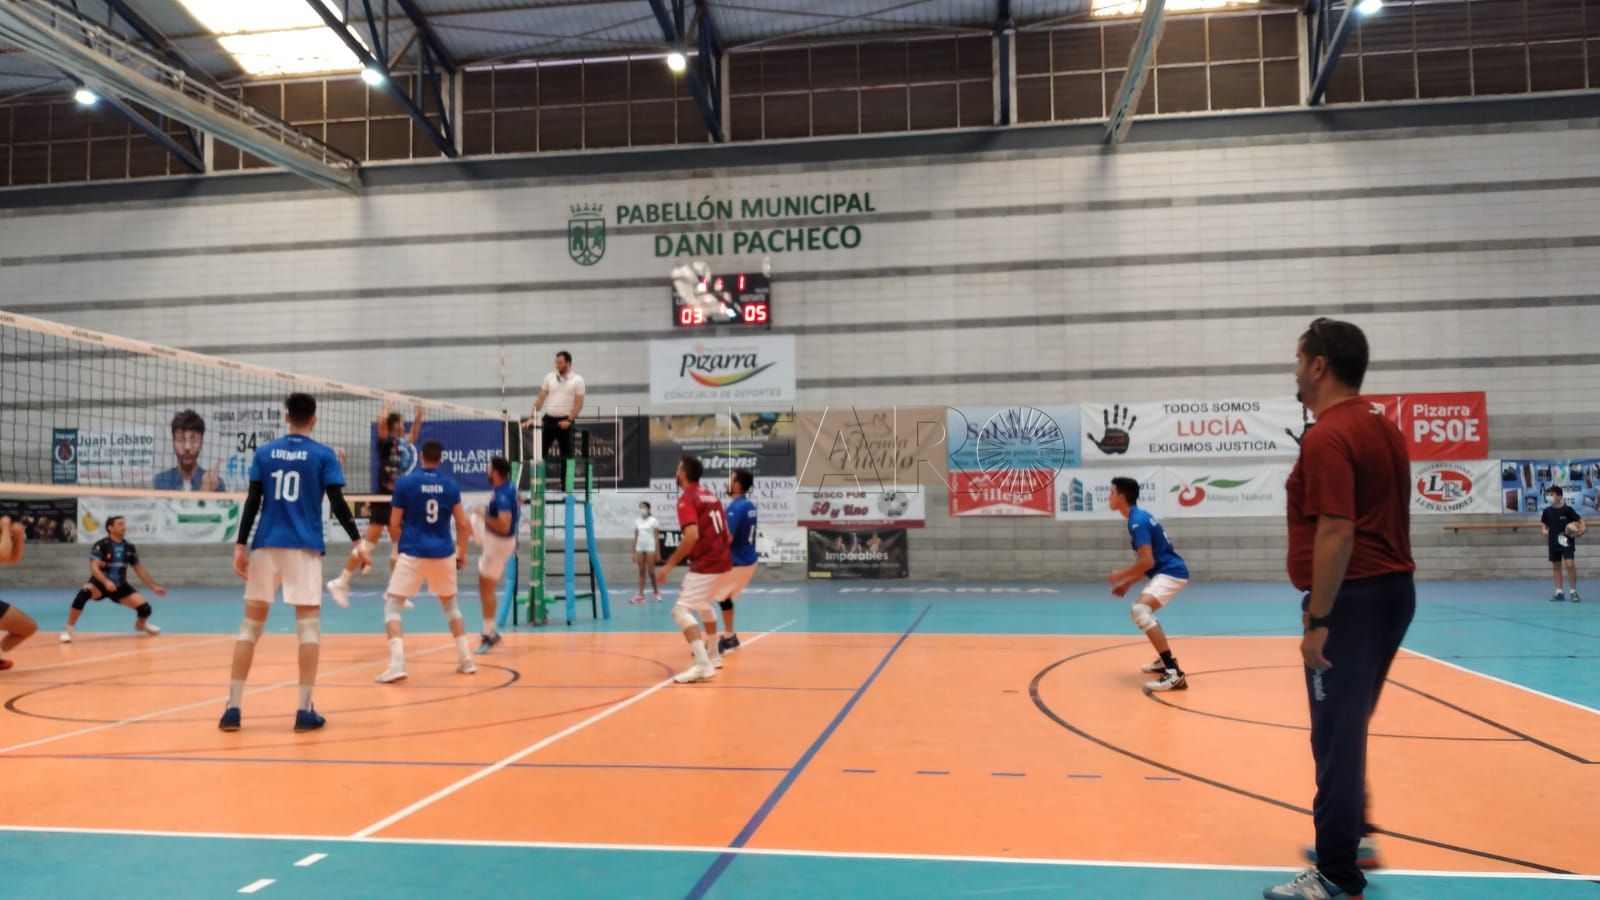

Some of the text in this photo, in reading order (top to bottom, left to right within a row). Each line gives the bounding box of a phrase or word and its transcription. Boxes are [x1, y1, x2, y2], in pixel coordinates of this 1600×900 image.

[616, 192, 876, 224] PABELLÓN MUNICIPAL
[654, 225, 862, 257] DANI PACHECO
[681, 308, 703, 324] 03
[744, 304, 767, 322] 05
[1163, 401, 1260, 414] TODOS SOMOS
[1413, 403, 1470, 417] Pizarra
[1177, 415, 1248, 437] LUCÍA
[1414, 418, 1480, 443] PSOE
[79, 435, 106, 446] Juan
[110, 434, 153, 445] Lobato
[1149, 440, 1277, 453] EXIGIMOS JUSTICIA
[453, 462, 487, 473] PIZAR
[271, 469, 300, 502] 10
[426, 499, 439, 523] 9
[709, 510, 723, 534] 11
[825, 551, 889, 562] Imparables
